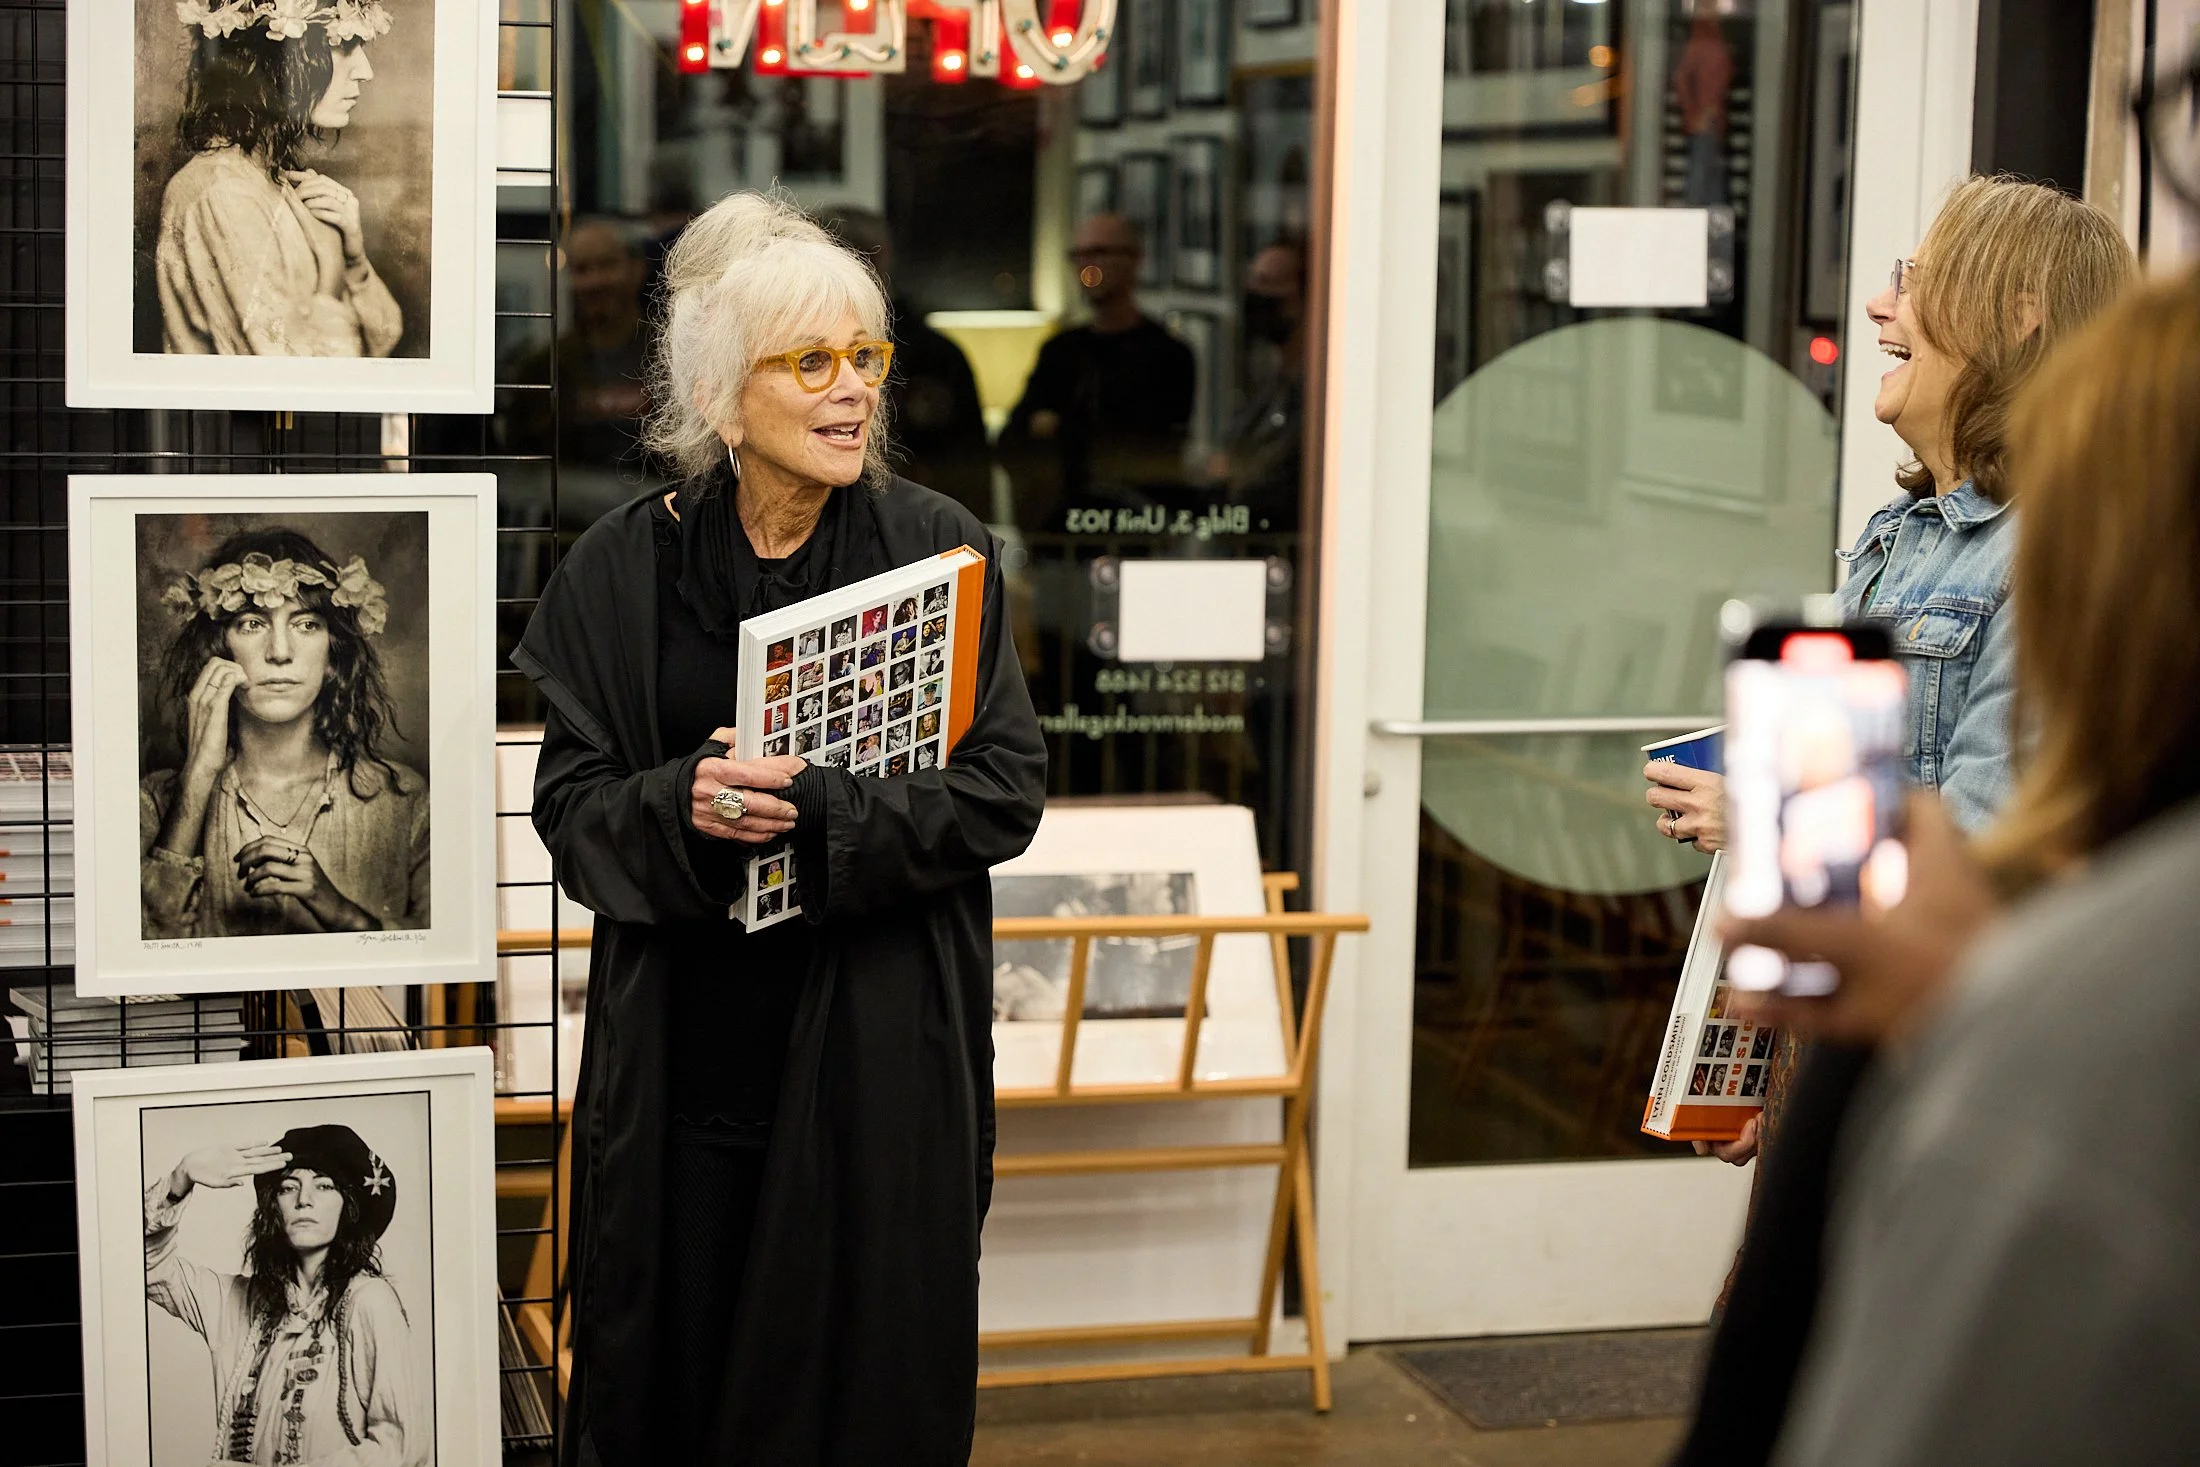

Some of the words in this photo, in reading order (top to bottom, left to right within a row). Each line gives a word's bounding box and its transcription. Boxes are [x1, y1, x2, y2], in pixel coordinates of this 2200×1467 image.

[1652, 1087, 1664, 1118] LYNN
[1661, 1015, 1682, 1083] GOLDSMITH
[1726, 1020, 1754, 1096] MUSIC
